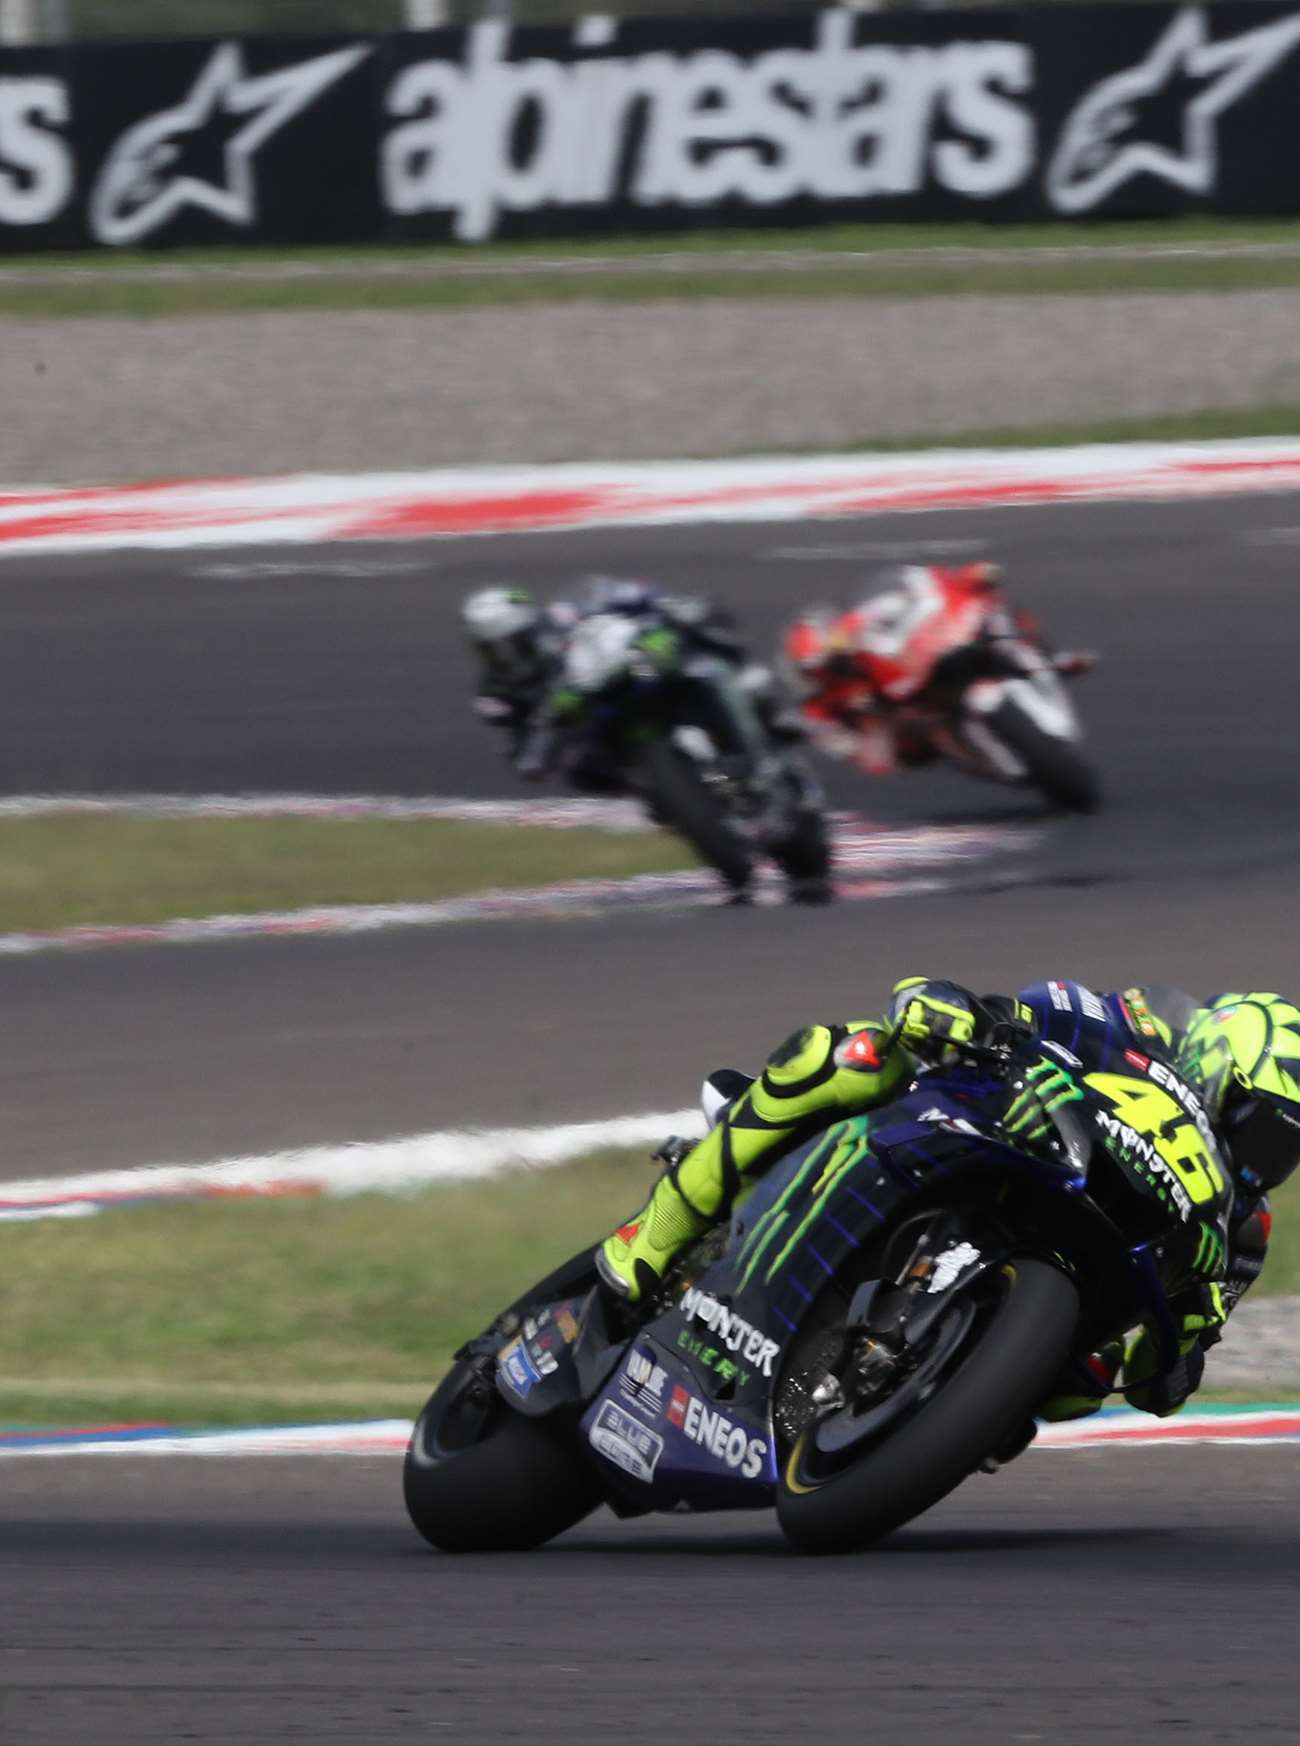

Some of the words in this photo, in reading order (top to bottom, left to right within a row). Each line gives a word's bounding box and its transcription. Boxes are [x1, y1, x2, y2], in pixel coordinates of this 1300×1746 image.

[381, 8, 1035, 240] alpinestars
[1082, 1072, 1224, 1205] 46
[1095, 1109, 1192, 1223] MONSTER
[683, 1396, 768, 1479] ENEOS
